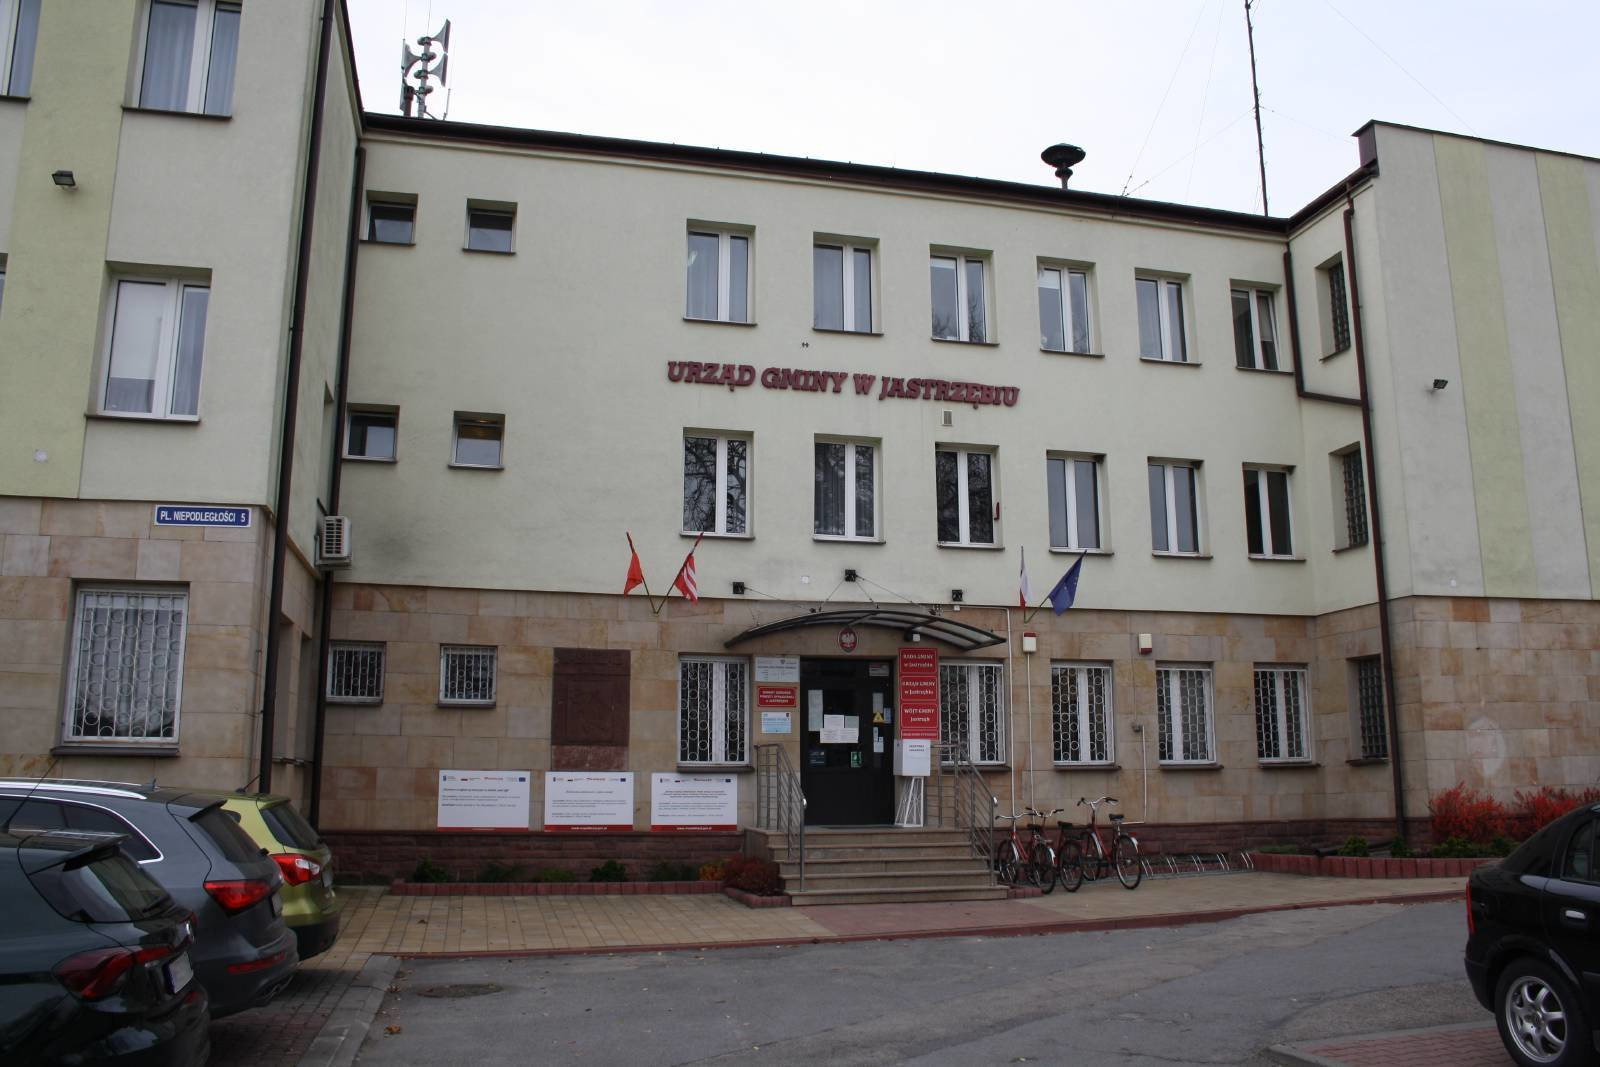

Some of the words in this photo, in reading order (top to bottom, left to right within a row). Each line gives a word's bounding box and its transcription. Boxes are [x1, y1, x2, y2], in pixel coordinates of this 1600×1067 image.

[667, 360, 756, 392] URZĄD
[761, 366, 848, 394] GMINY
[853, 372, 877, 396] W
[879, 375, 1020, 410] JASTRZĘBIU
[160, 510, 172, 521] PL.
[173, 510, 236, 523] NIEPODLEGŁOŚCI
[240, 512, 246, 523] 5
